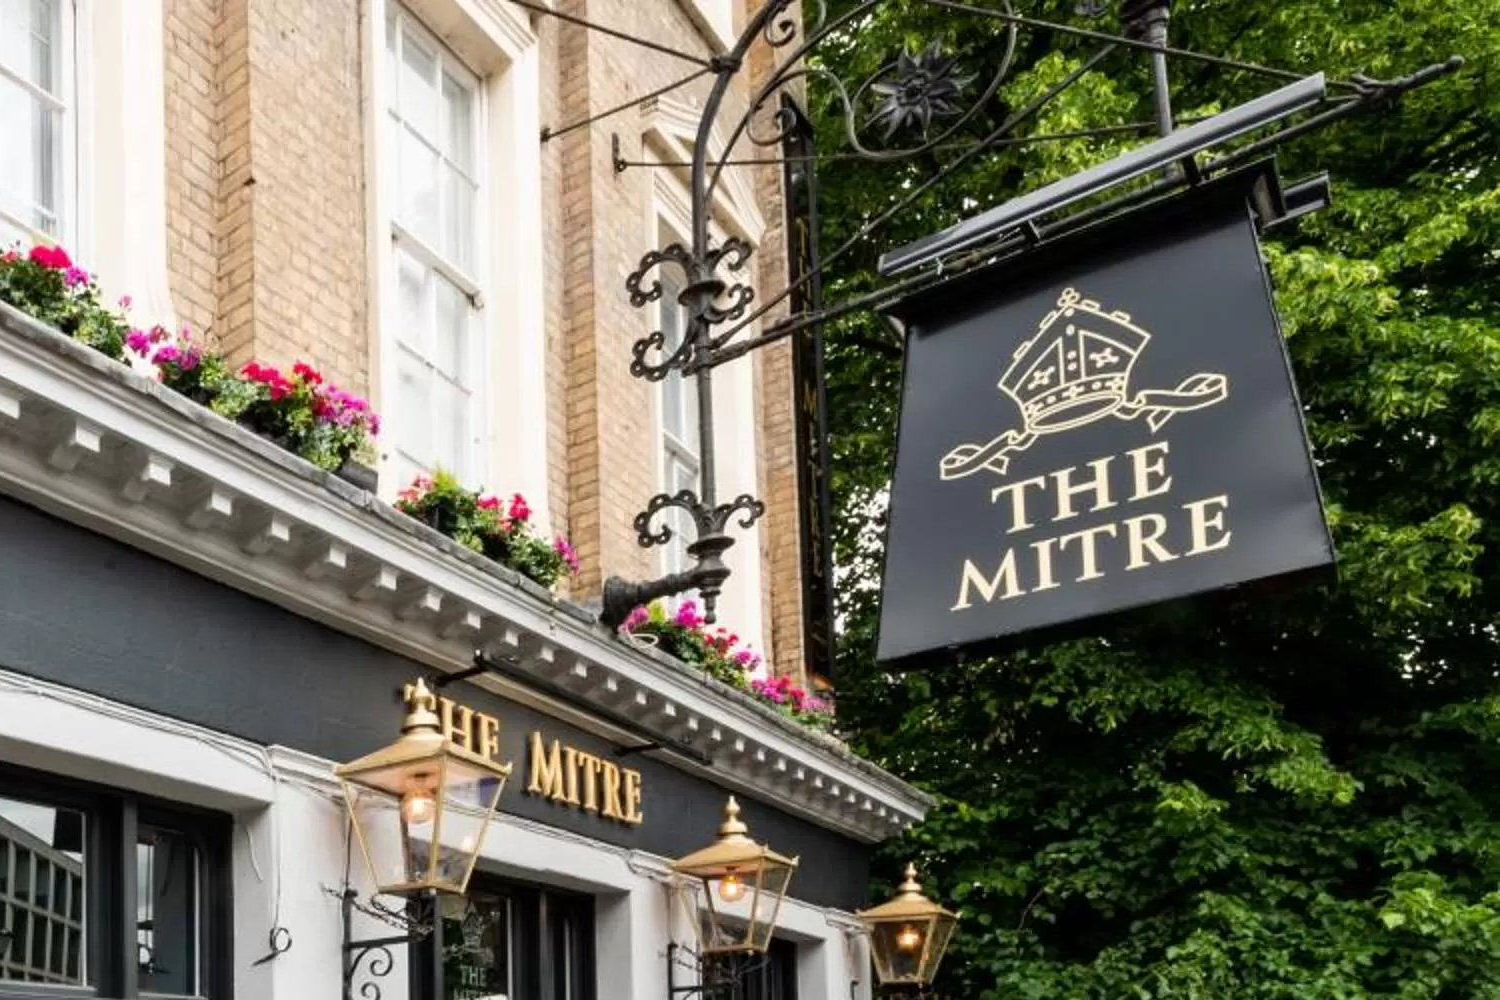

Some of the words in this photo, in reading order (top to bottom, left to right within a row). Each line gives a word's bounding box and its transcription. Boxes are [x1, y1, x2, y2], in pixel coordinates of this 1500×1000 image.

[991, 440, 1173, 534] THE
[949, 494, 1232, 613] MITRE
[527, 731, 644, 824] MITRE
